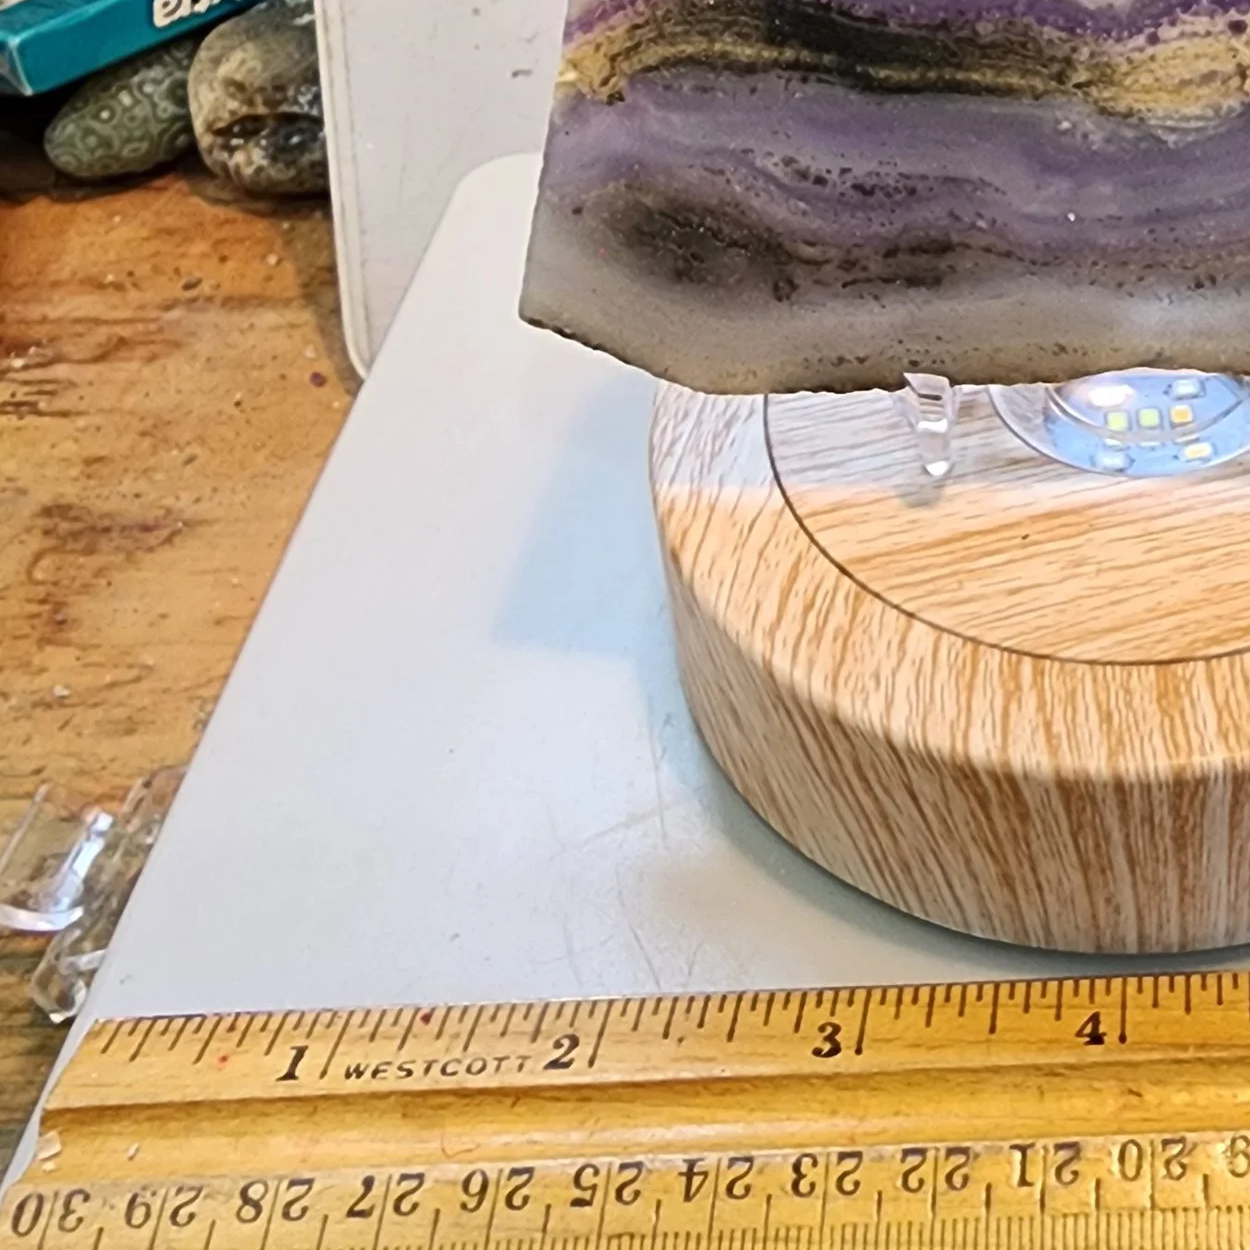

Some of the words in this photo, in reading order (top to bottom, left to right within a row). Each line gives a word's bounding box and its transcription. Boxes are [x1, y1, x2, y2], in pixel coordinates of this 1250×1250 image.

[277, 1045, 308, 1081] 1
[544, 1034, 581, 1071] 2
[812, 1022, 842, 1060] 3
[1076, 1011, 1107, 1046] 4
[344, 1055, 532, 1080] WESTCOTT
[681, 1156, 756, 1201] 24
[791, 1151, 864, 1197] 23
[900, 1146, 972, 1192] 22
[1010, 1142, 1081, 1188] 21
[1118, 1138, 1190, 1181] 20
[125, 1183, 203, 1229] 29
[237, 1178, 314, 1222] 28
[347, 1173, 425, 1219] 27
[461, 1166, 534, 1213] 26
[570, 1160, 646, 1208] 25
[13, 1187, 91, 1235] 30
